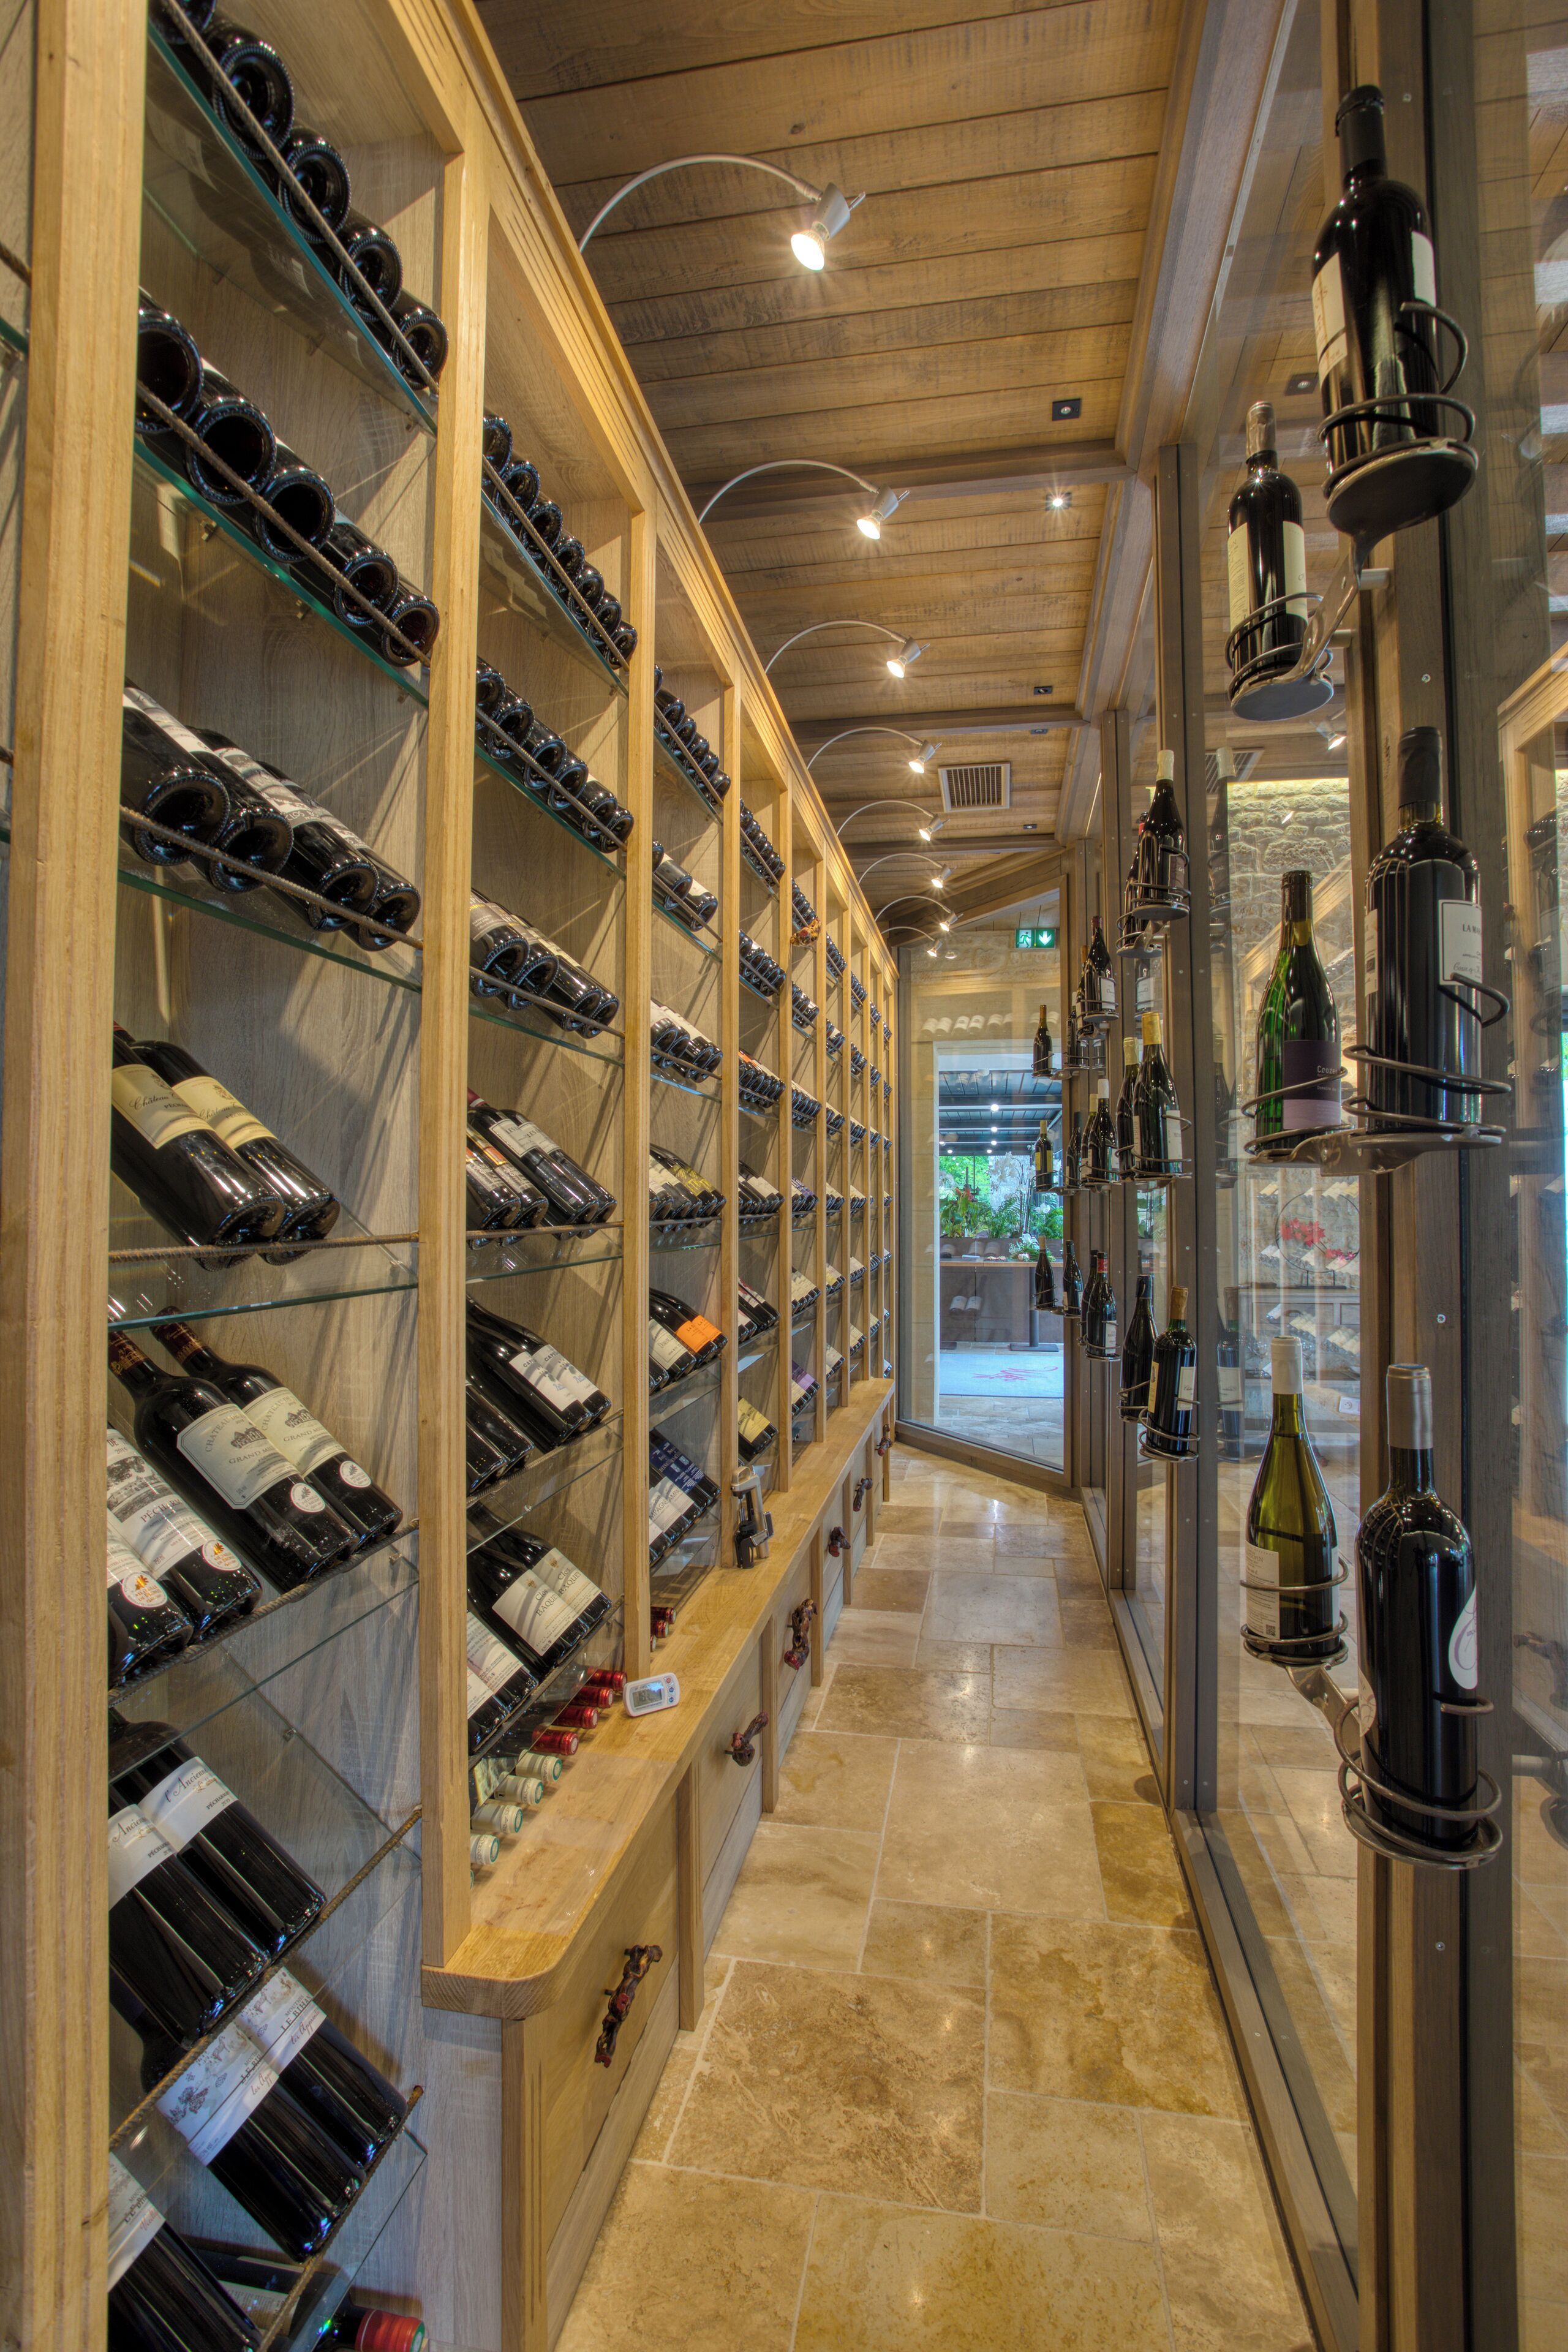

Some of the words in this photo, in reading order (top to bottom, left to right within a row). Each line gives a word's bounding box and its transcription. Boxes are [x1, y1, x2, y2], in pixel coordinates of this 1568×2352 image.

[205, 1415, 231, 1452] CHATEAU
[284, 1430, 312, 1442] GRAND
[228, 1449, 261, 1464] GRAND
[557, 1567, 571, 1581] Clos
[535, 1589, 549, 1601] Clos
[281, 2018, 292, 2032] LE
